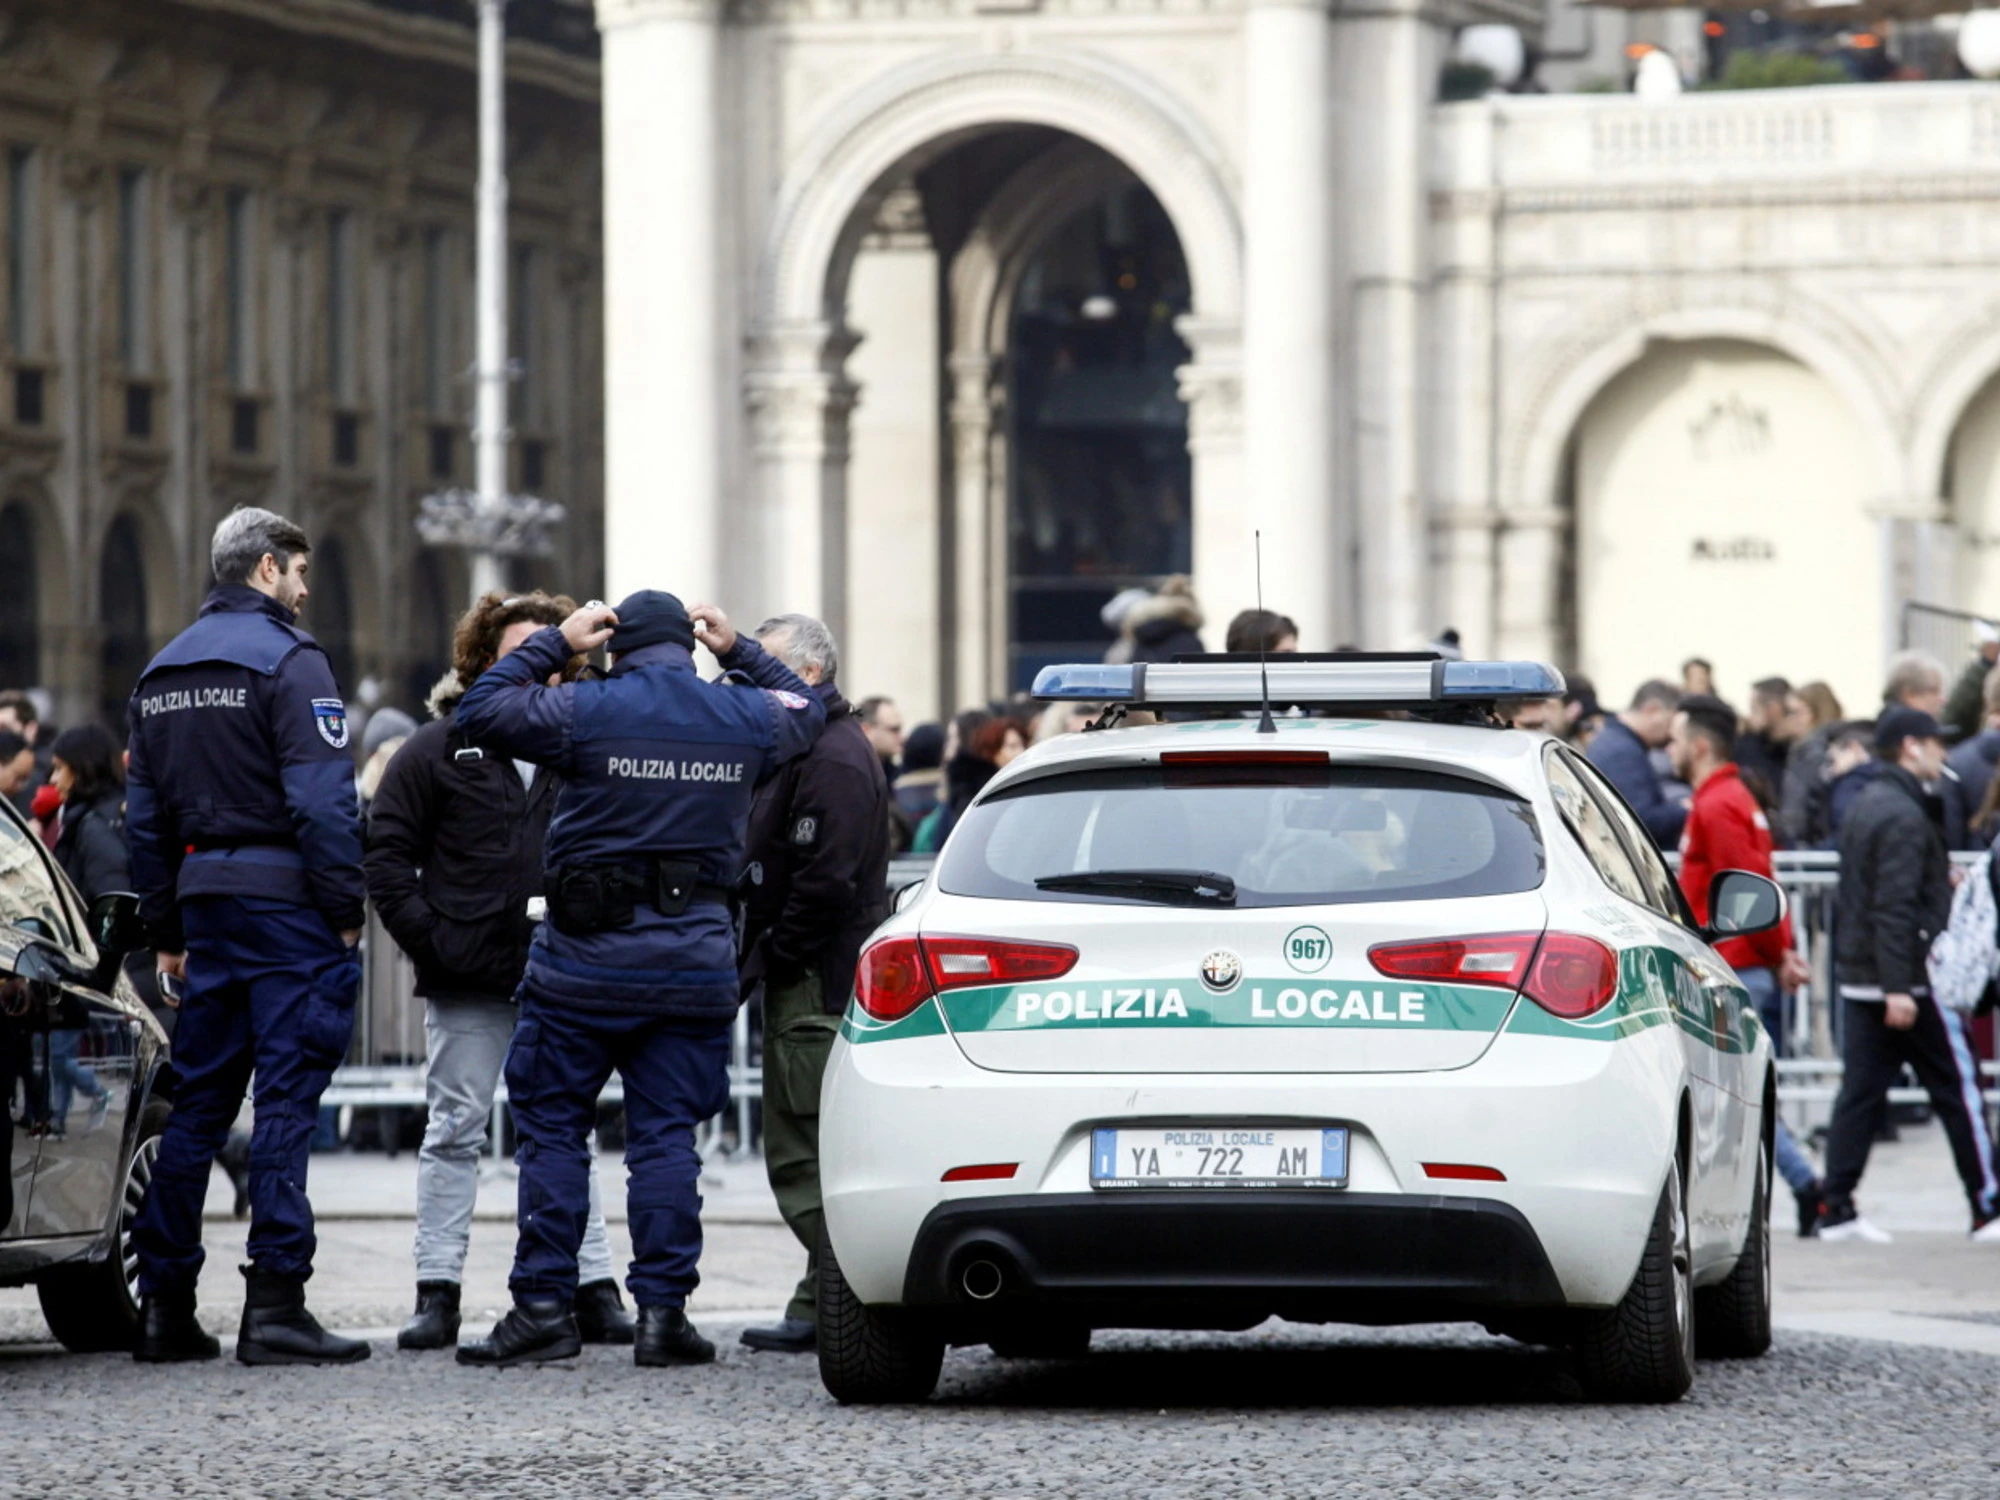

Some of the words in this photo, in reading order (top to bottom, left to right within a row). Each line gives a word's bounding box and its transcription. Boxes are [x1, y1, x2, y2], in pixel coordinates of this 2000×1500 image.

[142, 690, 191, 718] POLIZIA
[195, 688, 246, 708] LOCALE
[608, 757, 676, 780] POLIZIA
[680, 761, 744, 783] LOCALE
[1291, 938, 1326, 961] 967
[1016, 988, 1188, 1022] POLIZIA
[1252, 988, 1426, 1022] LOCALE
[1164, 1132, 1214, 1146] POLIZIA
[1222, 1132, 1275, 1146] LOCALE
[1131, 1147, 1161, 1176] YA
[1196, 1147, 1244, 1176] 722
[1276, 1147, 1308, 1176] AM
